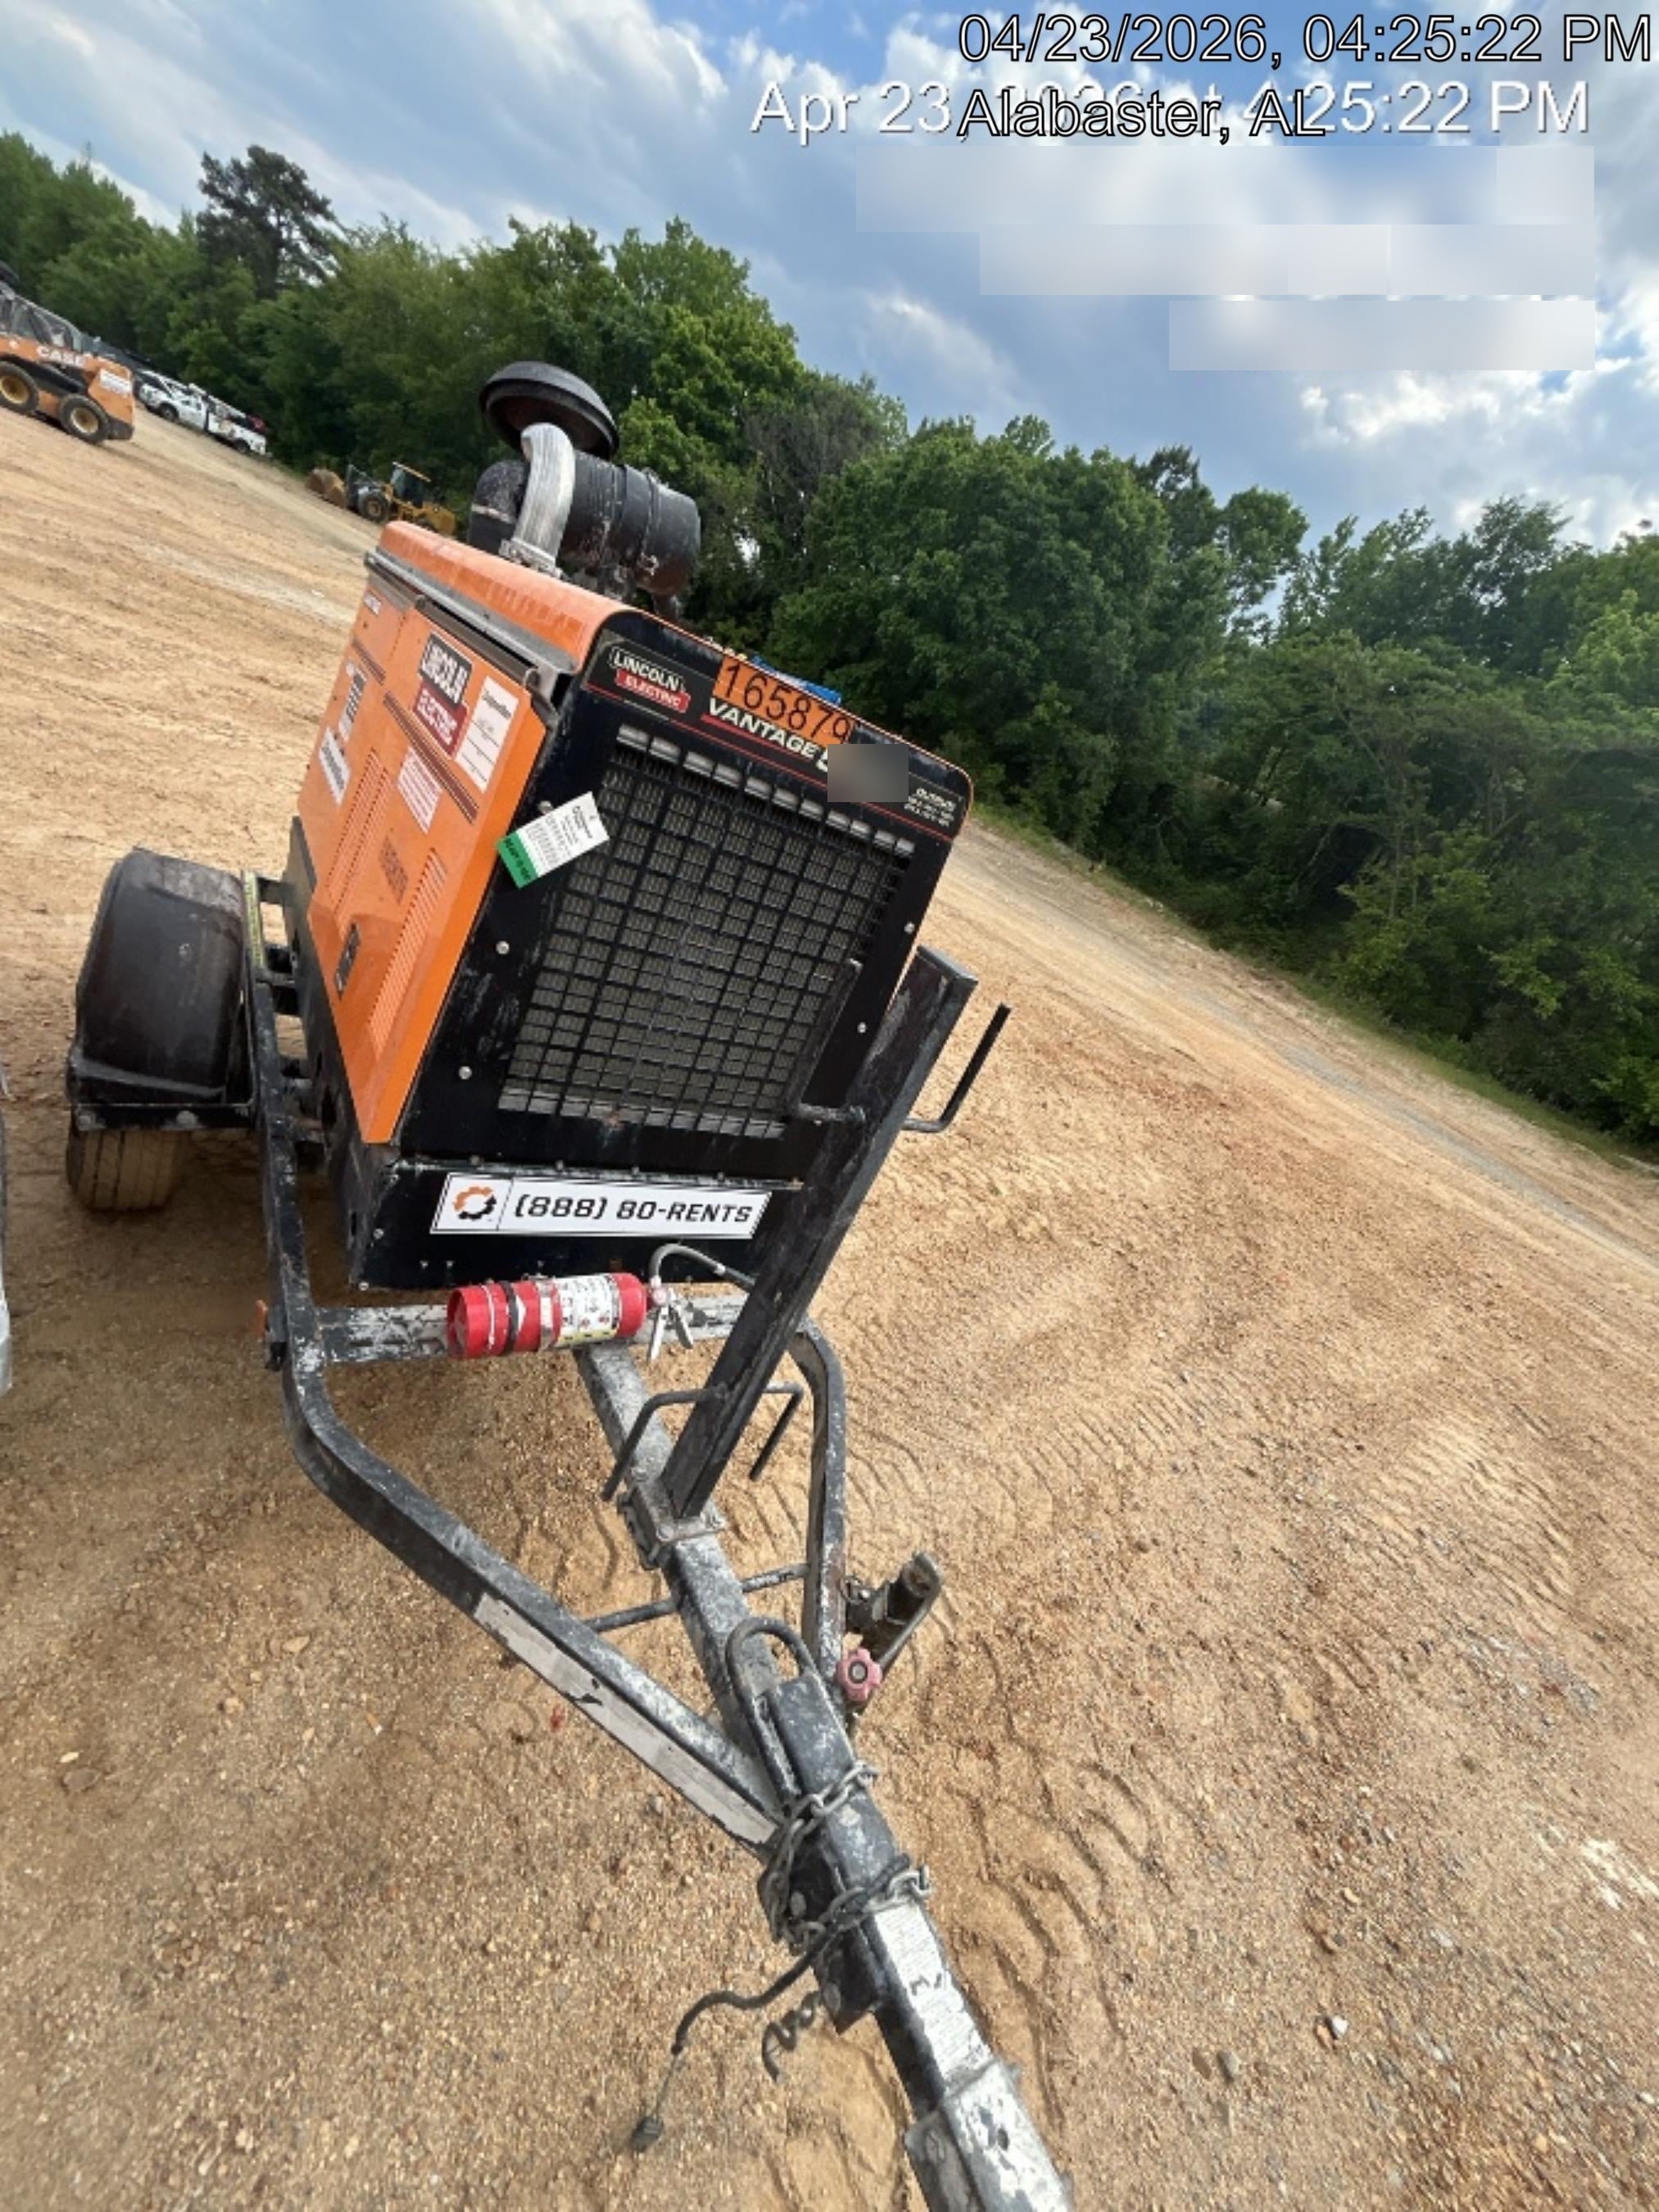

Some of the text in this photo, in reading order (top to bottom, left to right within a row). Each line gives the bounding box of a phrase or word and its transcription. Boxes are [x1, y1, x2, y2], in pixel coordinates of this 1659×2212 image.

[613, 650, 679, 691] LINCOLN
[709, 696, 819, 759] VANTAGE
[724, 662, 850, 746] 165879
[514, 1193, 753, 1222] (888) 80-RENTS
